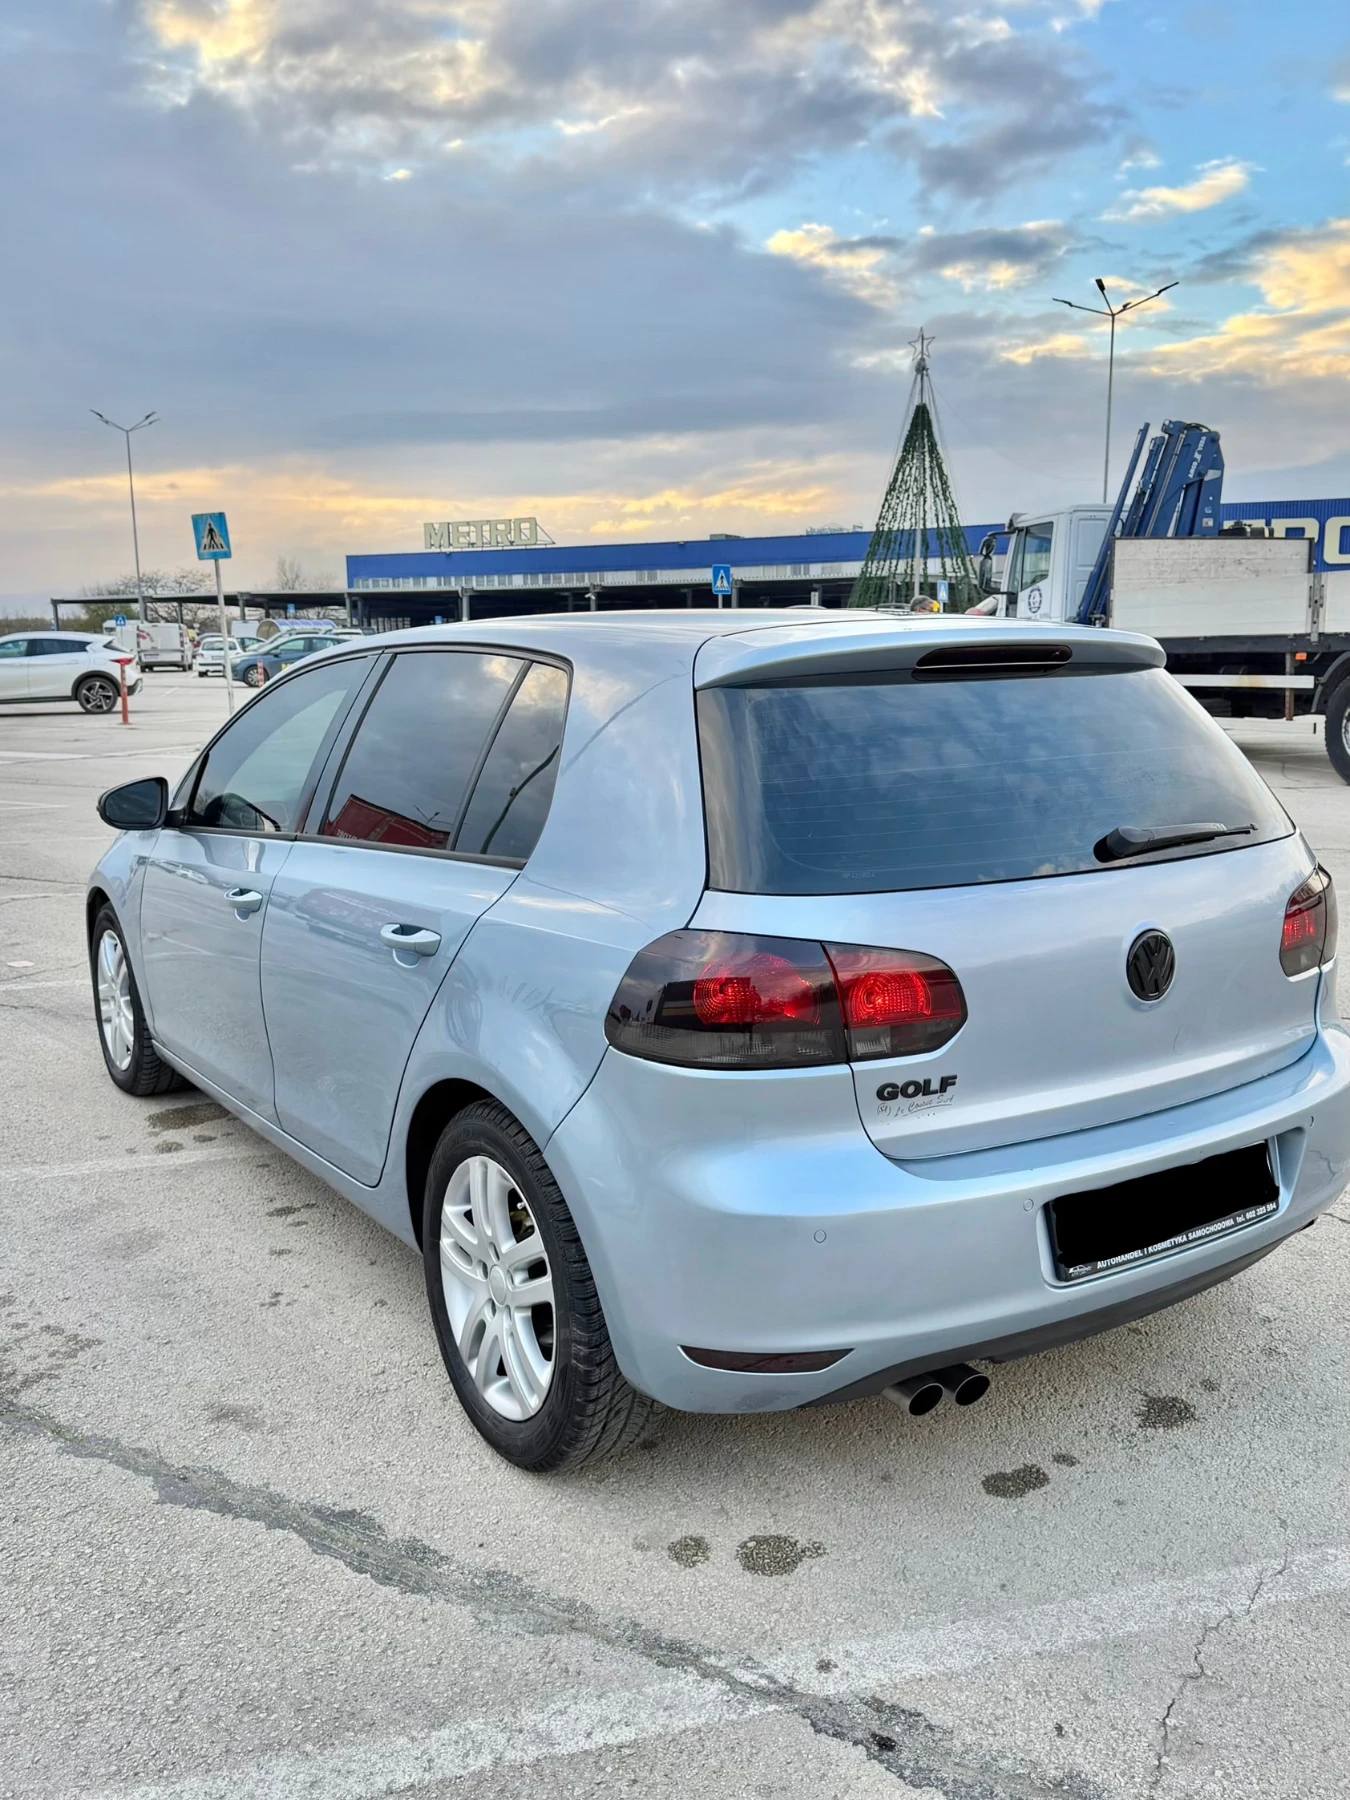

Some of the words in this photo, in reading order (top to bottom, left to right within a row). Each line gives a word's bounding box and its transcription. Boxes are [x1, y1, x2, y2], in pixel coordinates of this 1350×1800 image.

[424, 517, 537, 549] METRO
[876, 1074, 958, 1102] GOLF
[1096, 1249, 1143, 1269] AUTOHANDEL
[1148, 1235, 1188, 1254] KOSMETYKA
[1188, 1218, 1235, 1240] SAMOCHODOWA
